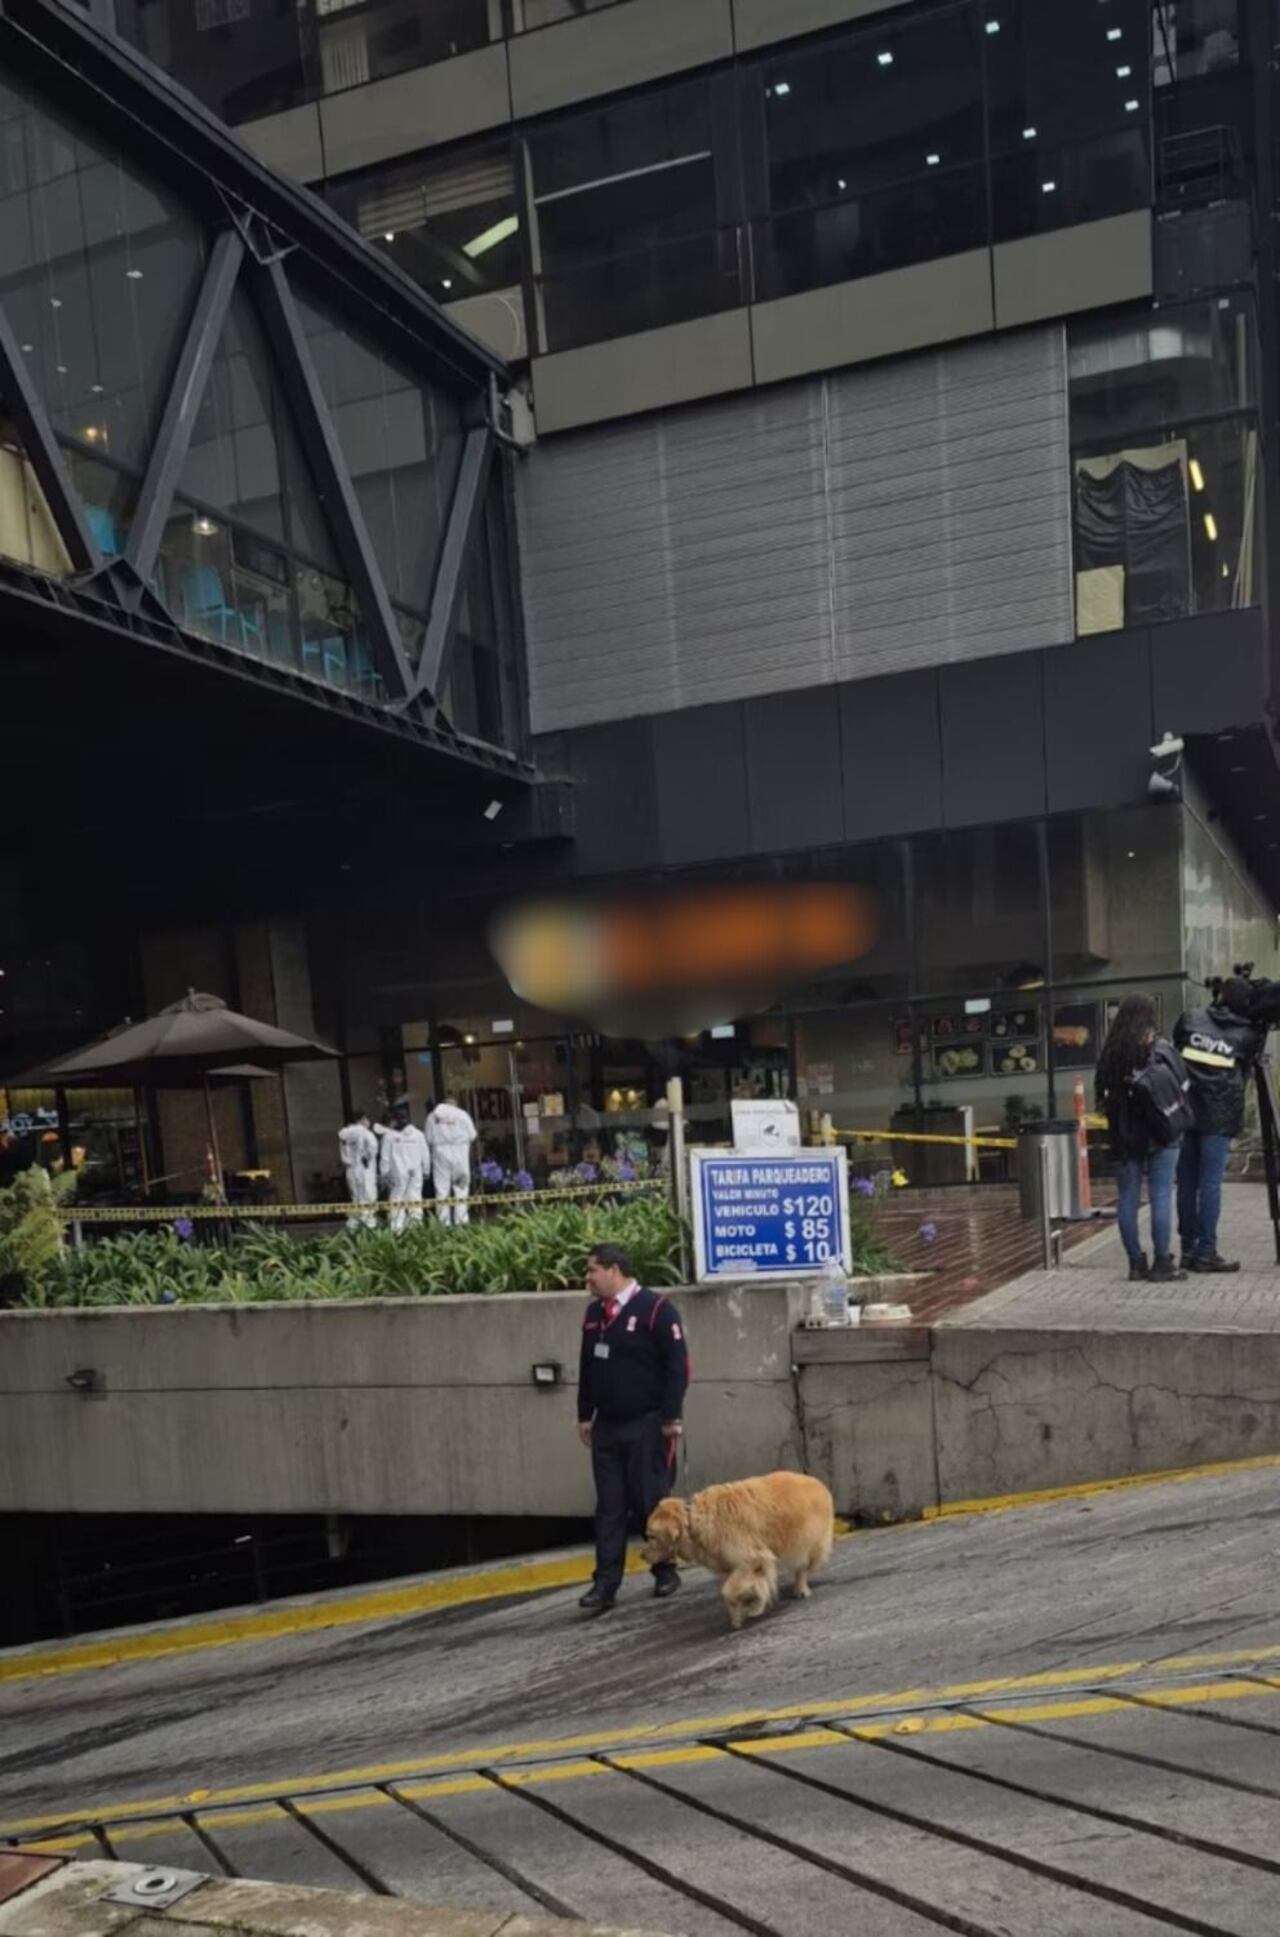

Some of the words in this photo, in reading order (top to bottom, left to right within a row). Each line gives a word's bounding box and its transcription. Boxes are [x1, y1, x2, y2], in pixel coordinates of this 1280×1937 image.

[1190, 1033, 1234, 1054] Citytv
[711, 1168, 750, 1185] TARIFA
[752, 1167, 830, 1184] PARQUEADERO
[712, 1189, 741, 1200] VALOR
[744, 1188, 779, 1199] MINUTO
[714, 1204, 779, 1217] VEHICULO
[783, 1196, 832, 1216] $120
[714, 1224, 756, 1237] MOTO
[802, 1219, 829, 1239] 85
[716, 1243, 778, 1257] BICICLETA
